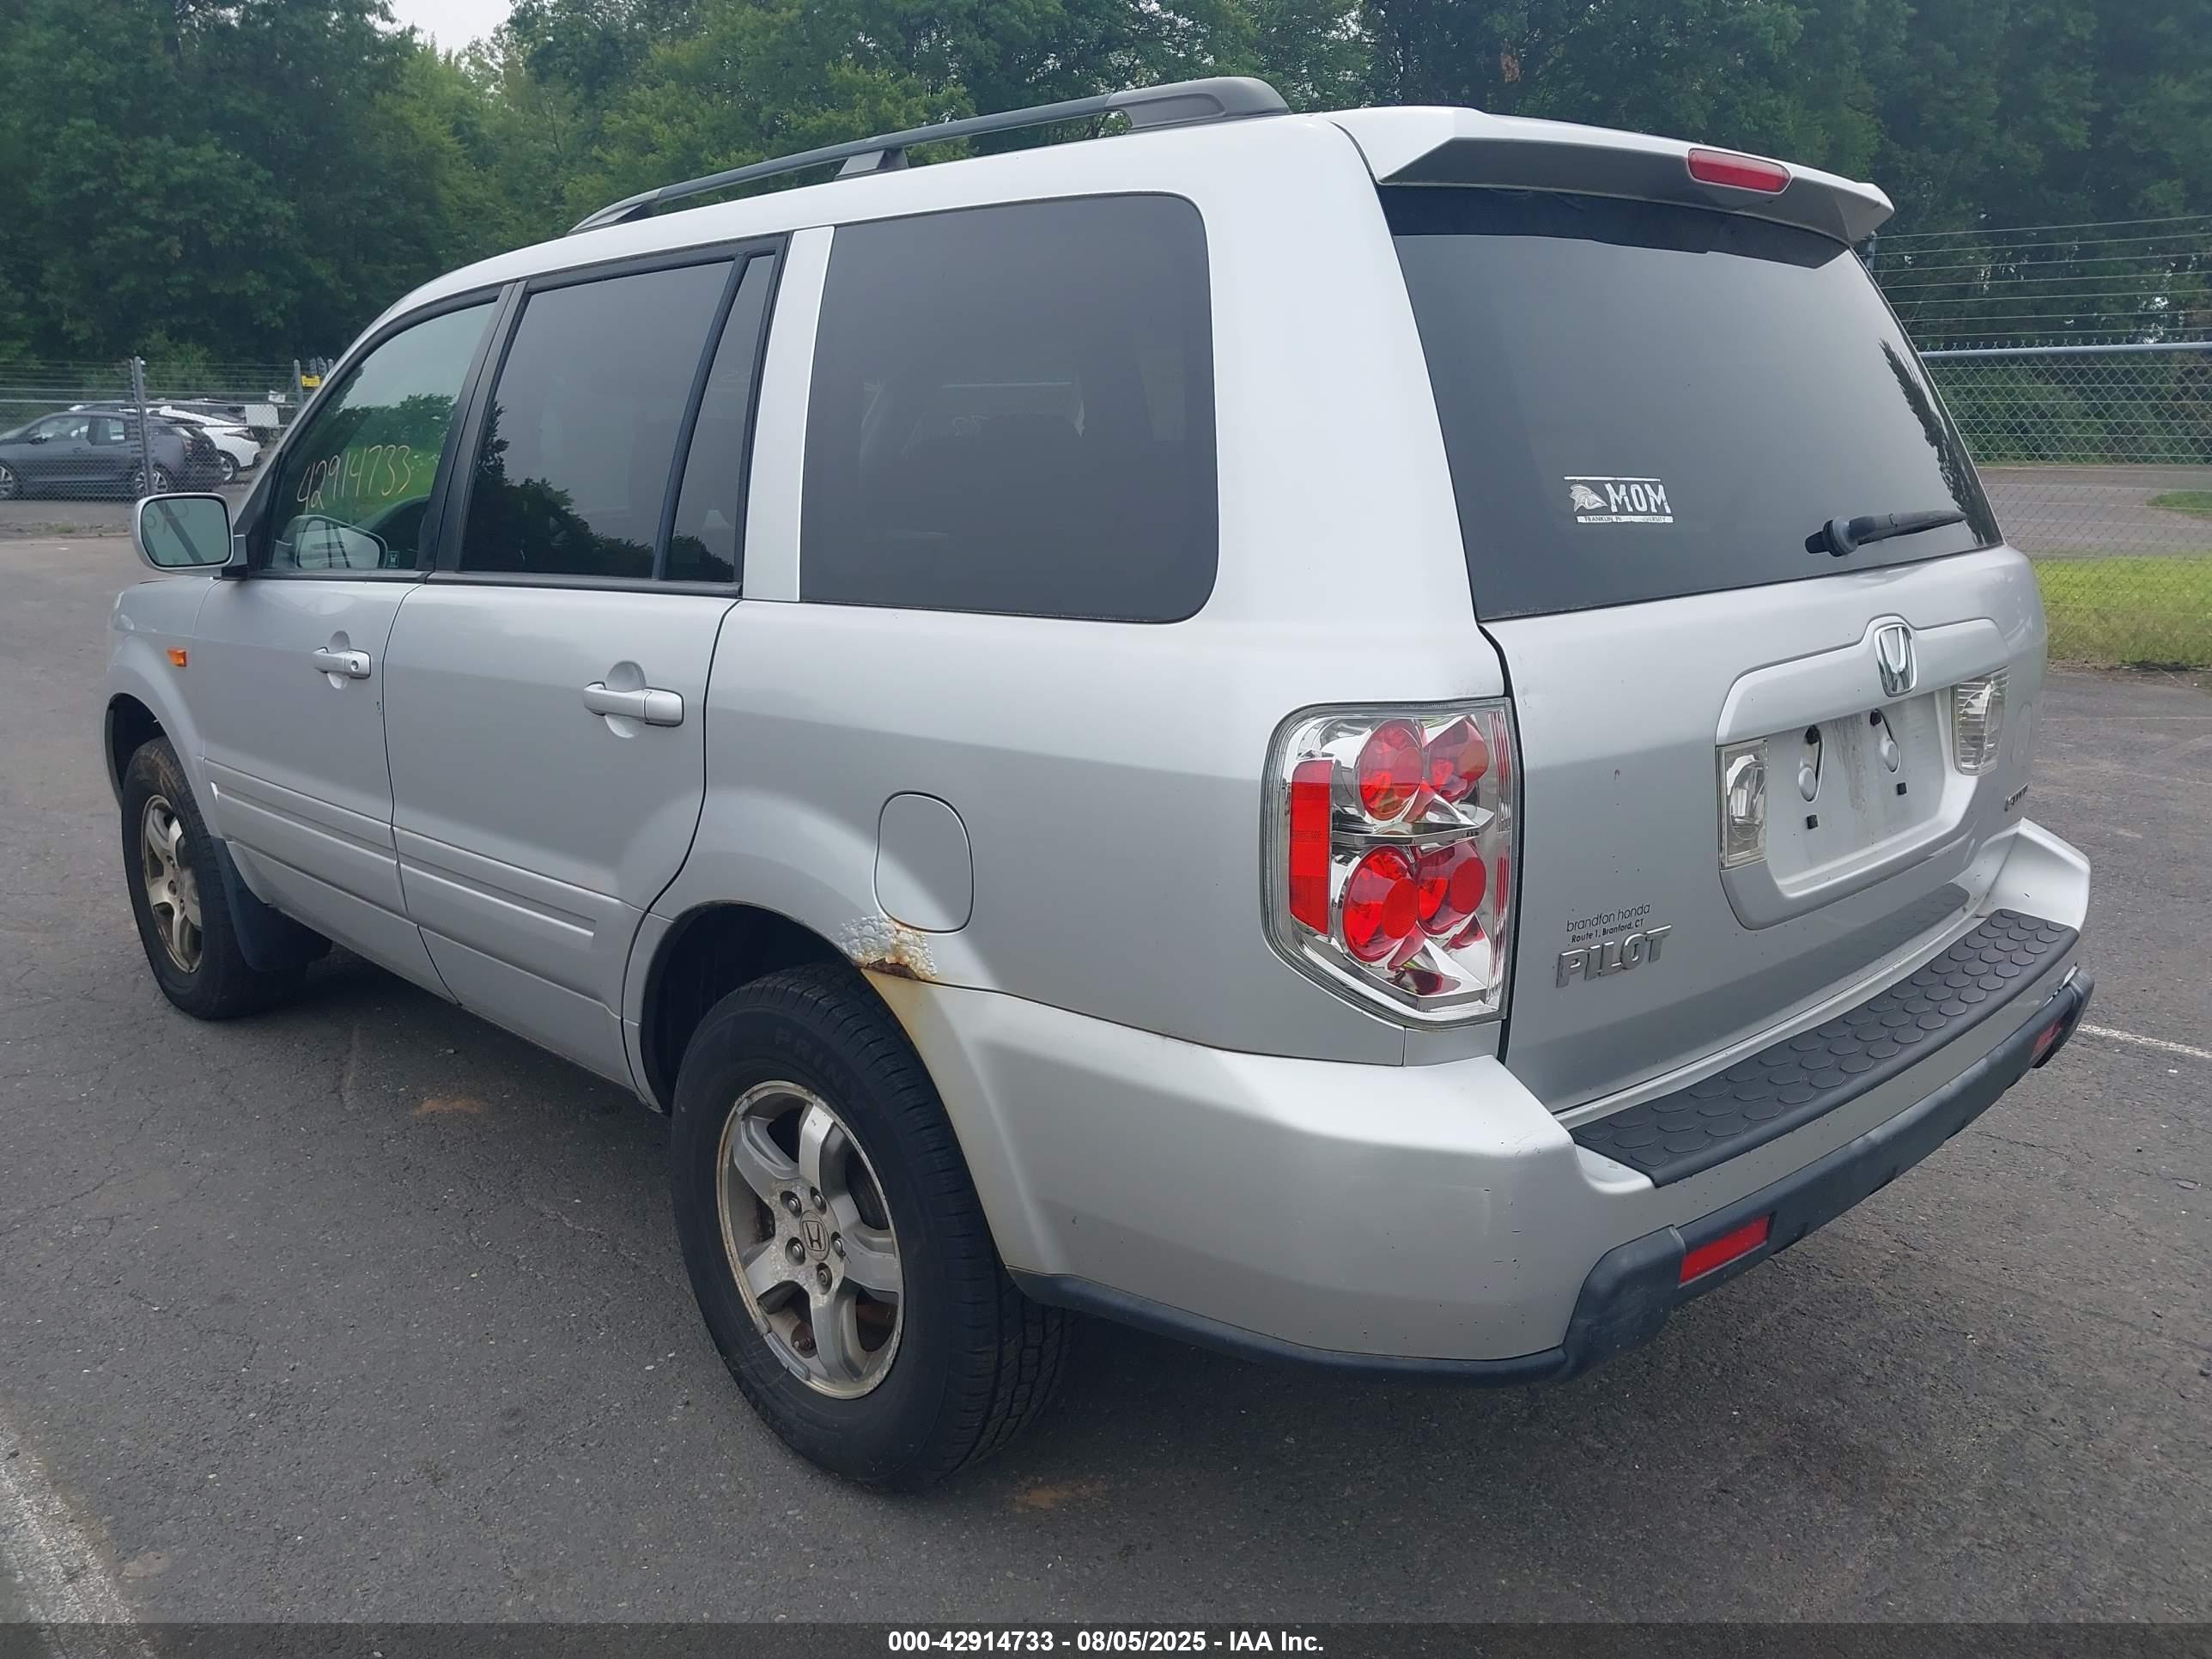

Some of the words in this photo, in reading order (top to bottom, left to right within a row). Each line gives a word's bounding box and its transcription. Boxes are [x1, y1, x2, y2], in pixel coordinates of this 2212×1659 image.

[296, 444, 410, 515] 42914733
[1604, 483, 1672, 514] MOM
[1566, 913, 1615, 933] brandfon
[1617, 903, 1651, 922] honda
[1571, 930, 1594, 943] Route
[1602, 921, 1633, 936] Branford,
[1634, 918, 1644, 928] CT
[1555, 924, 1673, 988] PILOT
